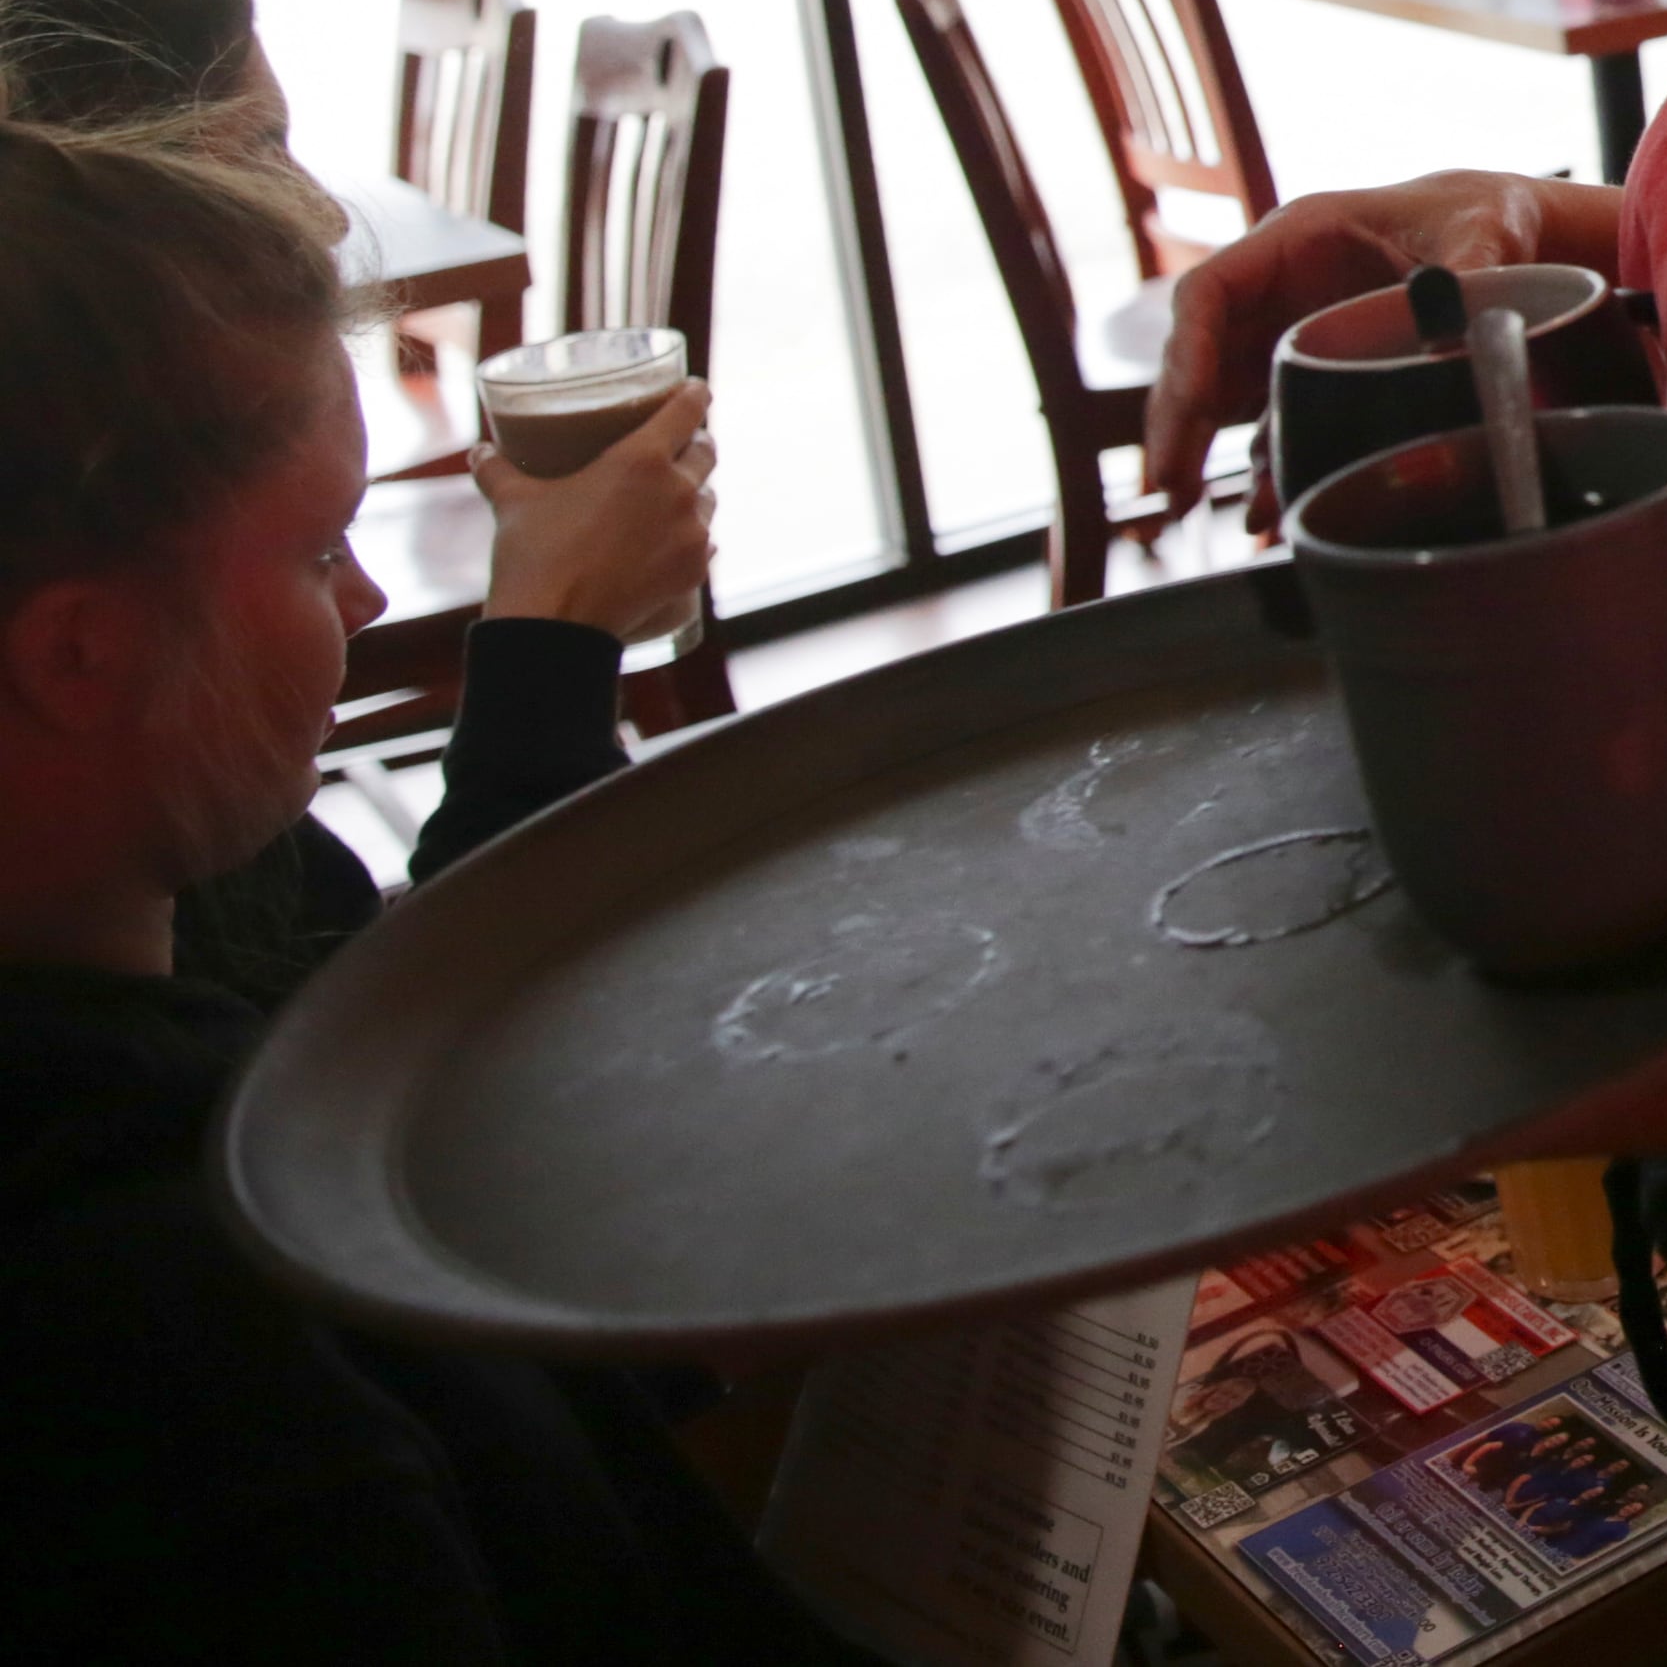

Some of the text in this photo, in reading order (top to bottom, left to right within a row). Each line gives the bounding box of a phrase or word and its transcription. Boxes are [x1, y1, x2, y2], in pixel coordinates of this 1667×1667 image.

[1571, 1377, 1601, 1401] Our
[1600, 1394, 1637, 1430] Mission
[1635, 1421, 1649, 1439] Is
[1061, 1558, 1091, 1583] and
[1406, 1531, 1440, 1560] come
[1431, 1552, 1451, 1573] by
[1029, 1606, 1069, 1642] event.
